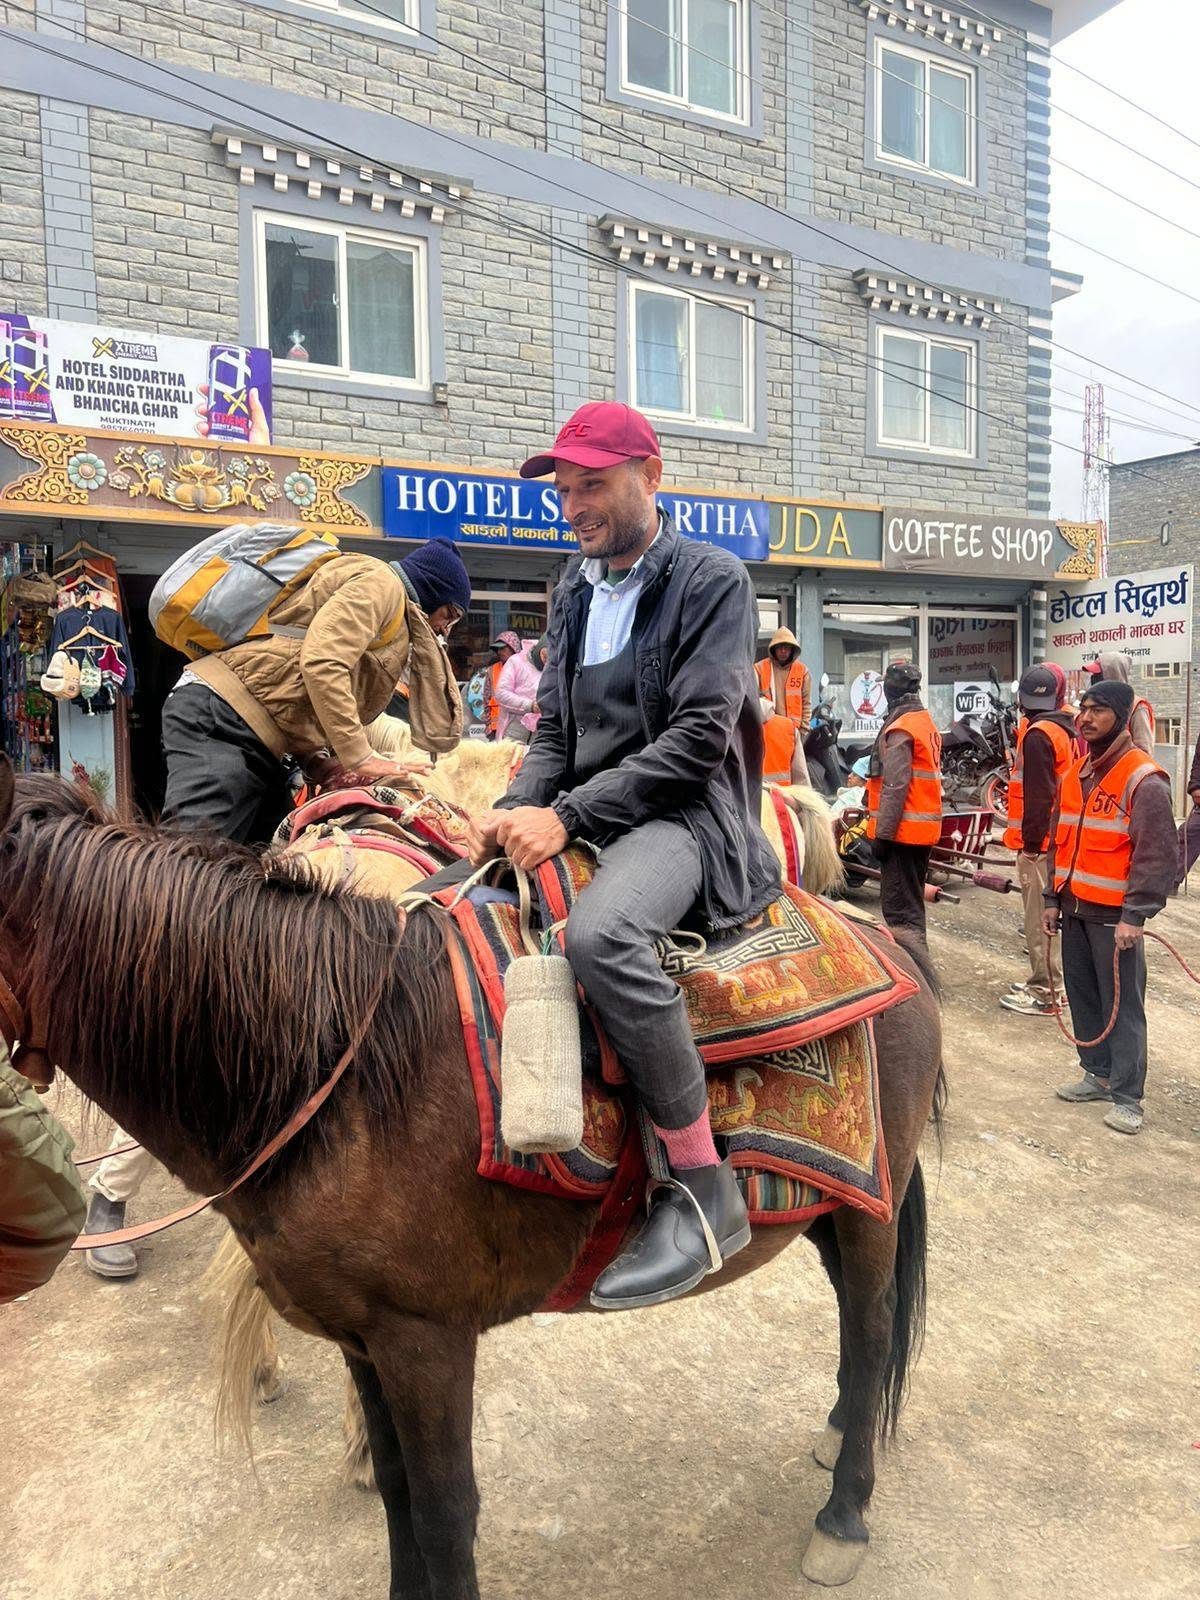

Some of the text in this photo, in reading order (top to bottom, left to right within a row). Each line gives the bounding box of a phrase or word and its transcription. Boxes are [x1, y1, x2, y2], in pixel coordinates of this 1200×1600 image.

[115, 342, 156, 356] XTREME
[62, 359, 186, 387] HOTEL SIDDARTHA
[55, 375, 193, 404] AND KHANG THAKALI
[73, 394, 179, 419] BHANCHA GHAR
[100, 416, 155, 428] MUKTINATH
[396, 474, 532, 520] HOTEL
[512, 527, 558, 541] थकाली
[888, 517, 1053, 567] COFFEE SHOP
[1050, 570, 1189, 624] होटल सिद्धार्थ
[1089, 624, 1127, 643] थकाली
[1130, 622, 1164, 638] भान्छा
[1168, 620, 1186, 635] घर
[790, 677, 802, 688] 55
[856, 719, 885, 731] Hukk
